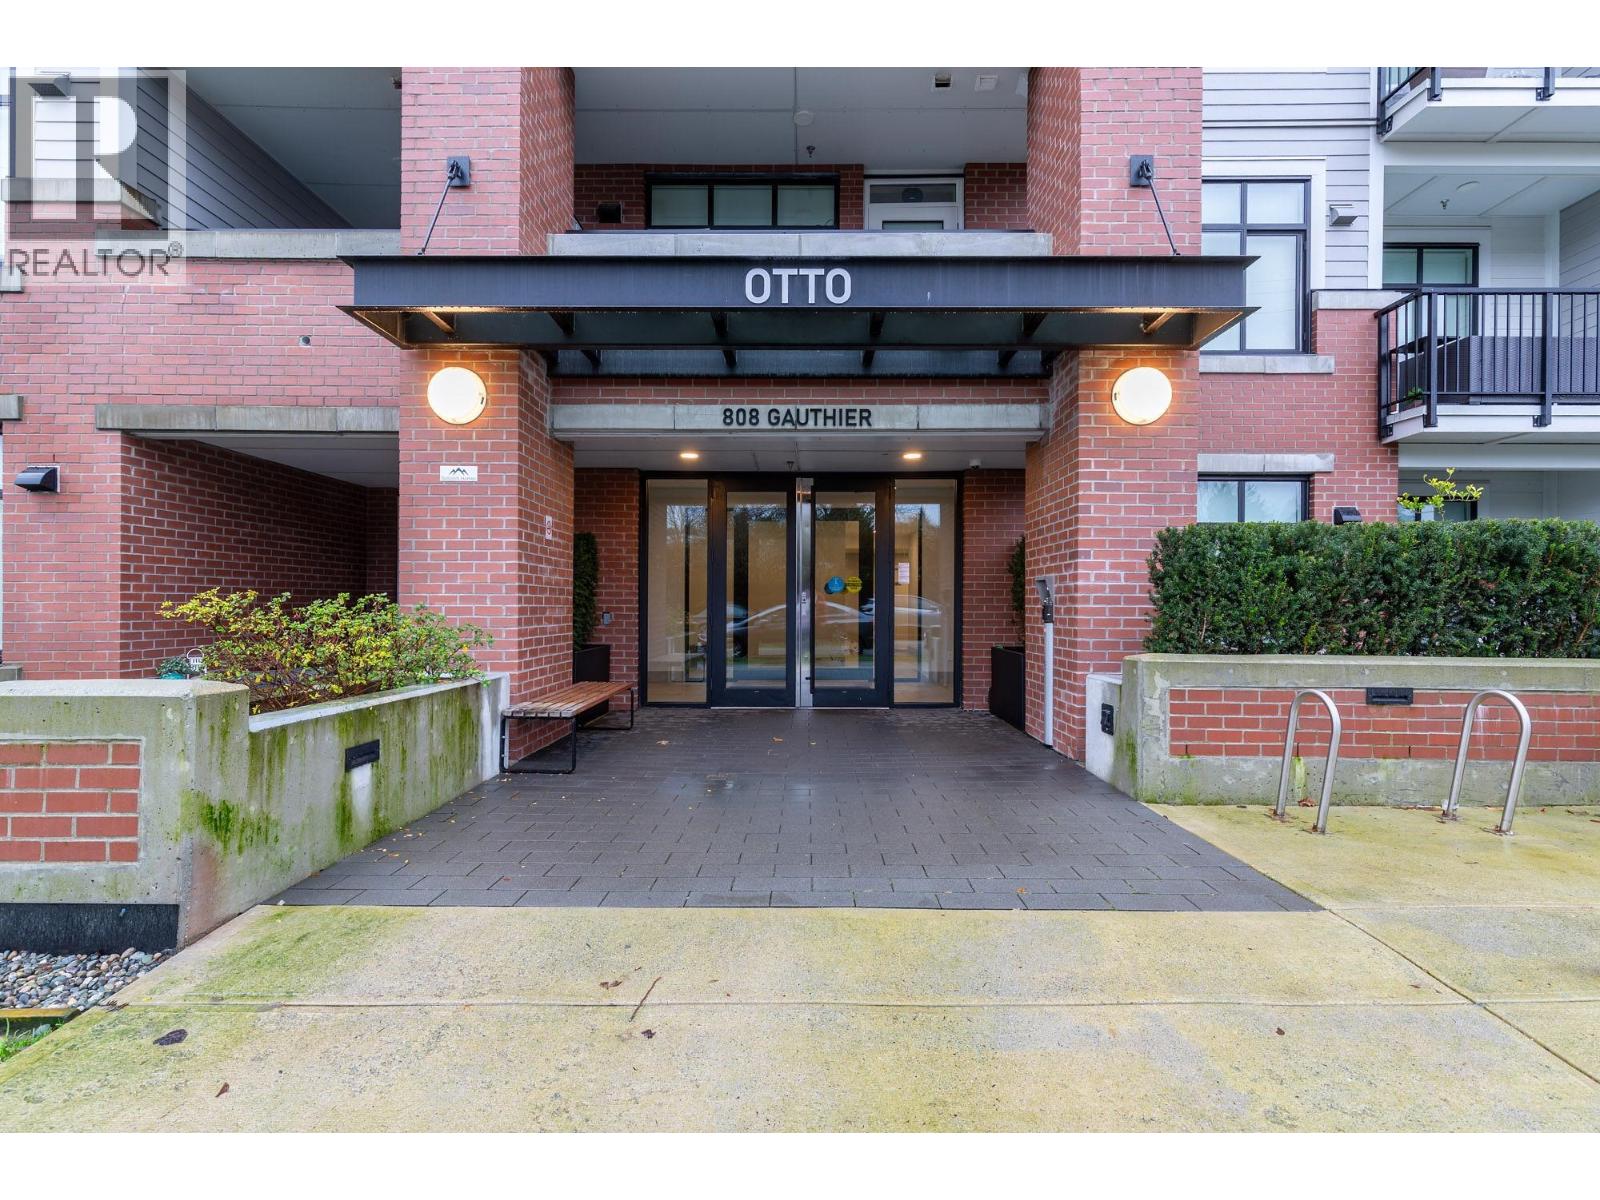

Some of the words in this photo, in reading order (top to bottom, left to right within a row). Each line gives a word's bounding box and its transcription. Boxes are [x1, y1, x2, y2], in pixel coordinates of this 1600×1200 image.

[745, 268, 851, 304] OTTO
[722, 408, 760, 426] 808
[767, 408, 872, 427] GAUTHIER
